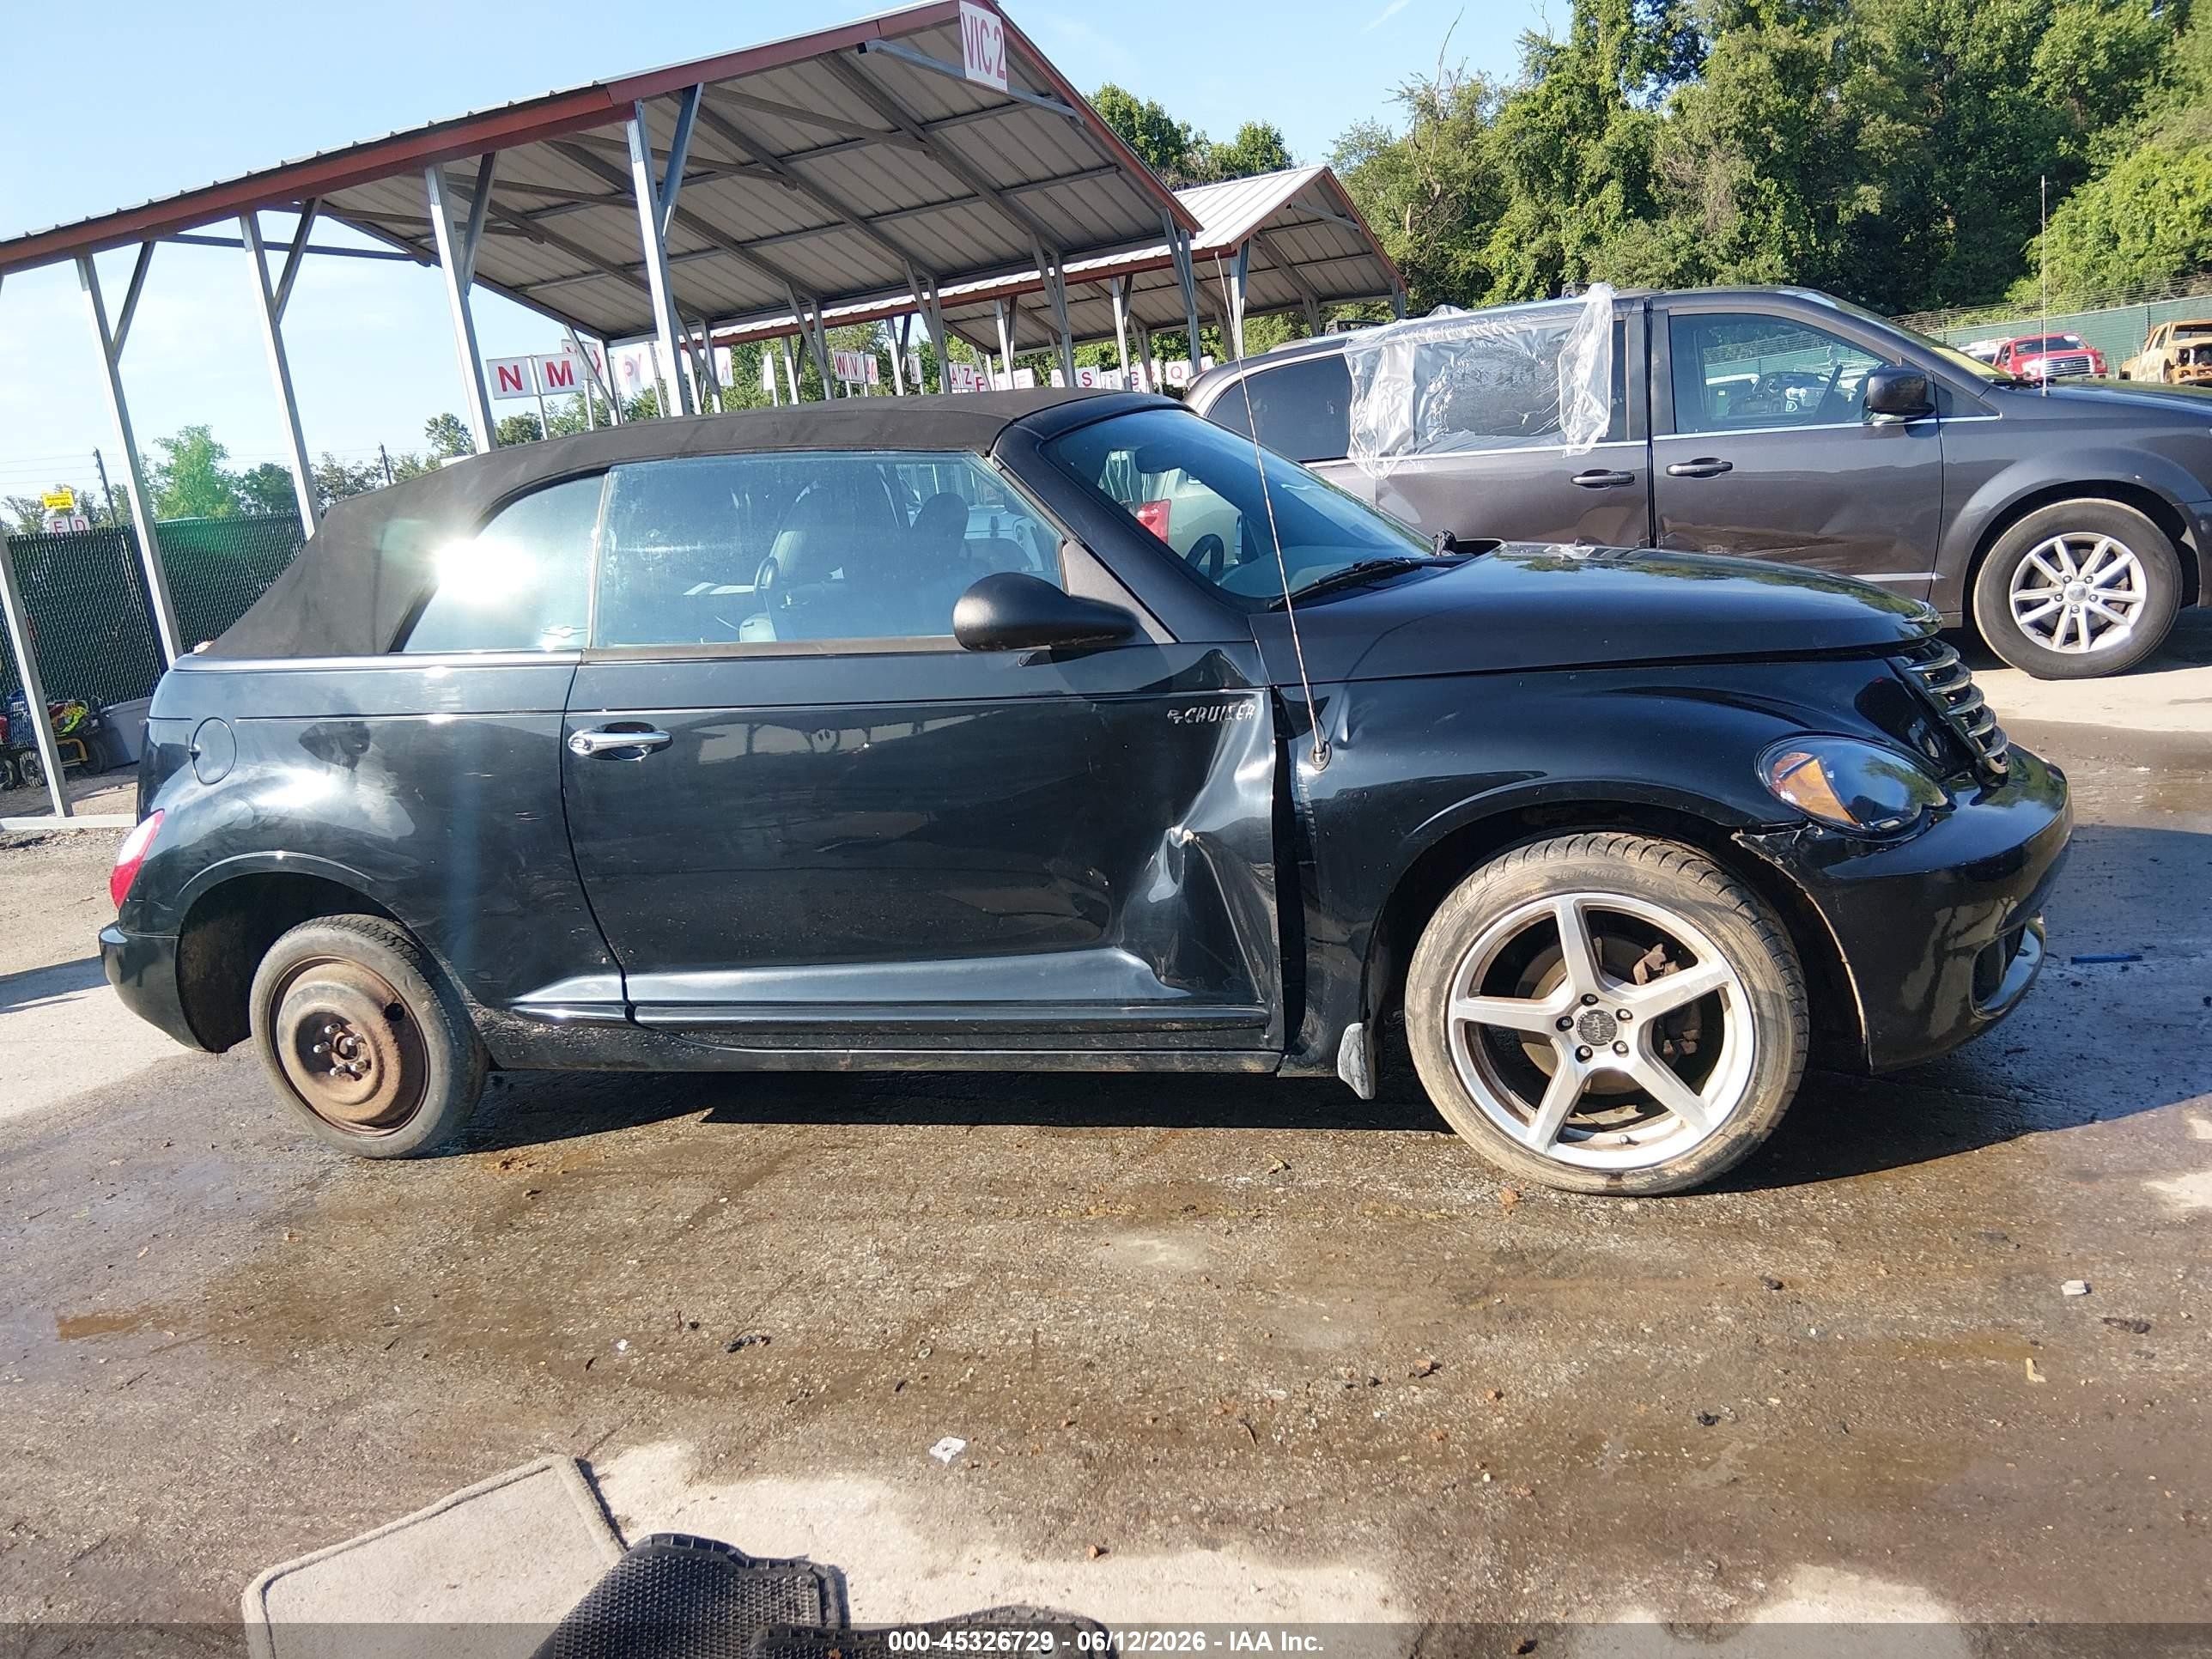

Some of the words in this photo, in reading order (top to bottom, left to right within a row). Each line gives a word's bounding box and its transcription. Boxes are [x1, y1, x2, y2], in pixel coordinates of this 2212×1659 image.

[545, 360, 574, 388] M
[834, 356, 846, 375] W
[850, 356, 858, 376] V
[1170, 366, 1183, 380] Q
[497, 364, 523, 392] N
[963, 368, 972, 385] Z
[1082, 372, 1092, 386] S
[1184, 702, 1256, 723] CRUISER
